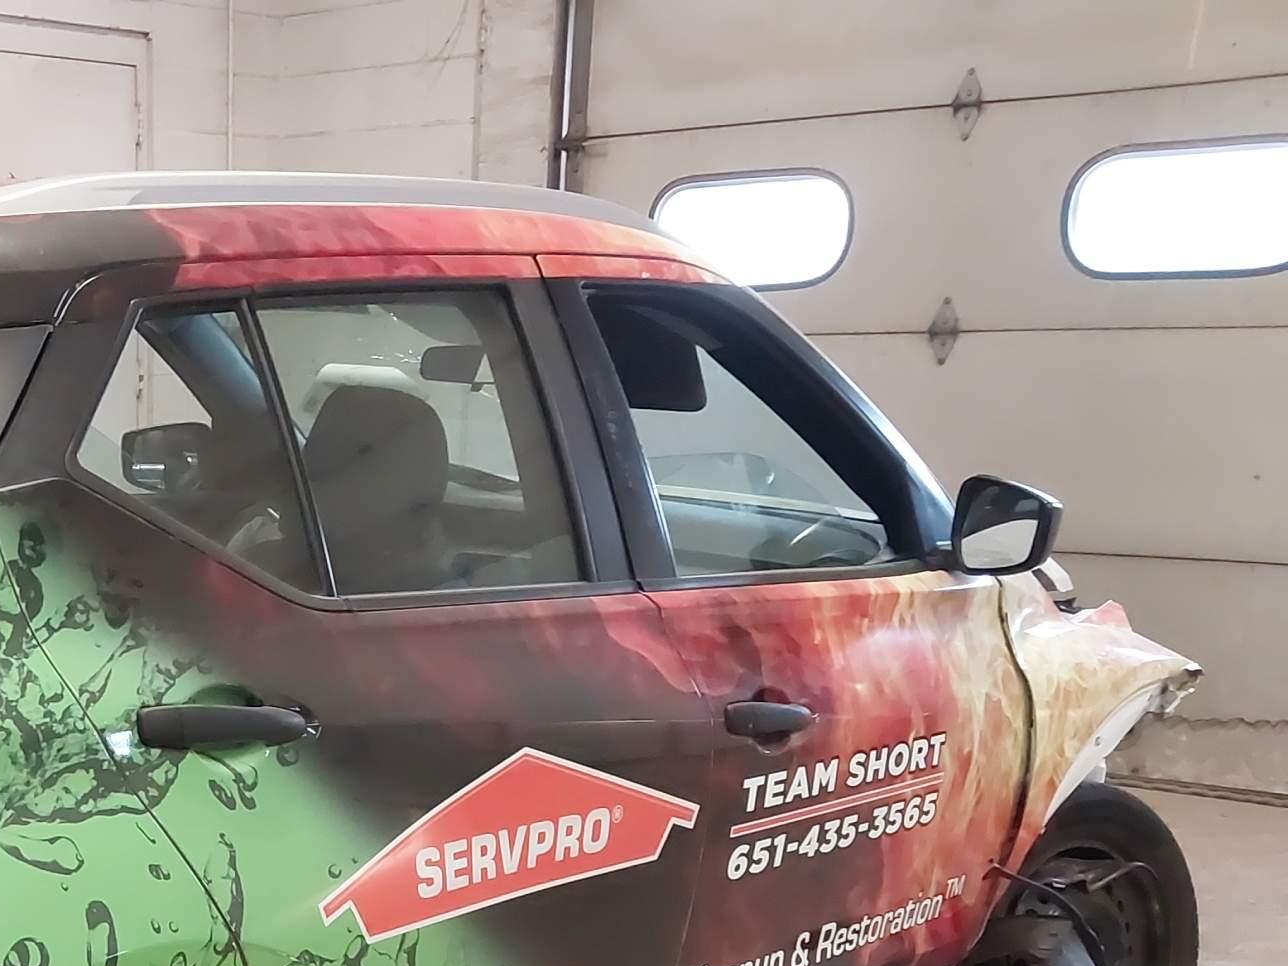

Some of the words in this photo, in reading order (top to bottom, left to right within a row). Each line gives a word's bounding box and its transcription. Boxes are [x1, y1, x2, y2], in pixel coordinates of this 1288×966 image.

[742, 757, 840, 813] TEAM
[846, 733, 946, 788] SHORT
[727, 792, 939, 881] 651-435-3565
